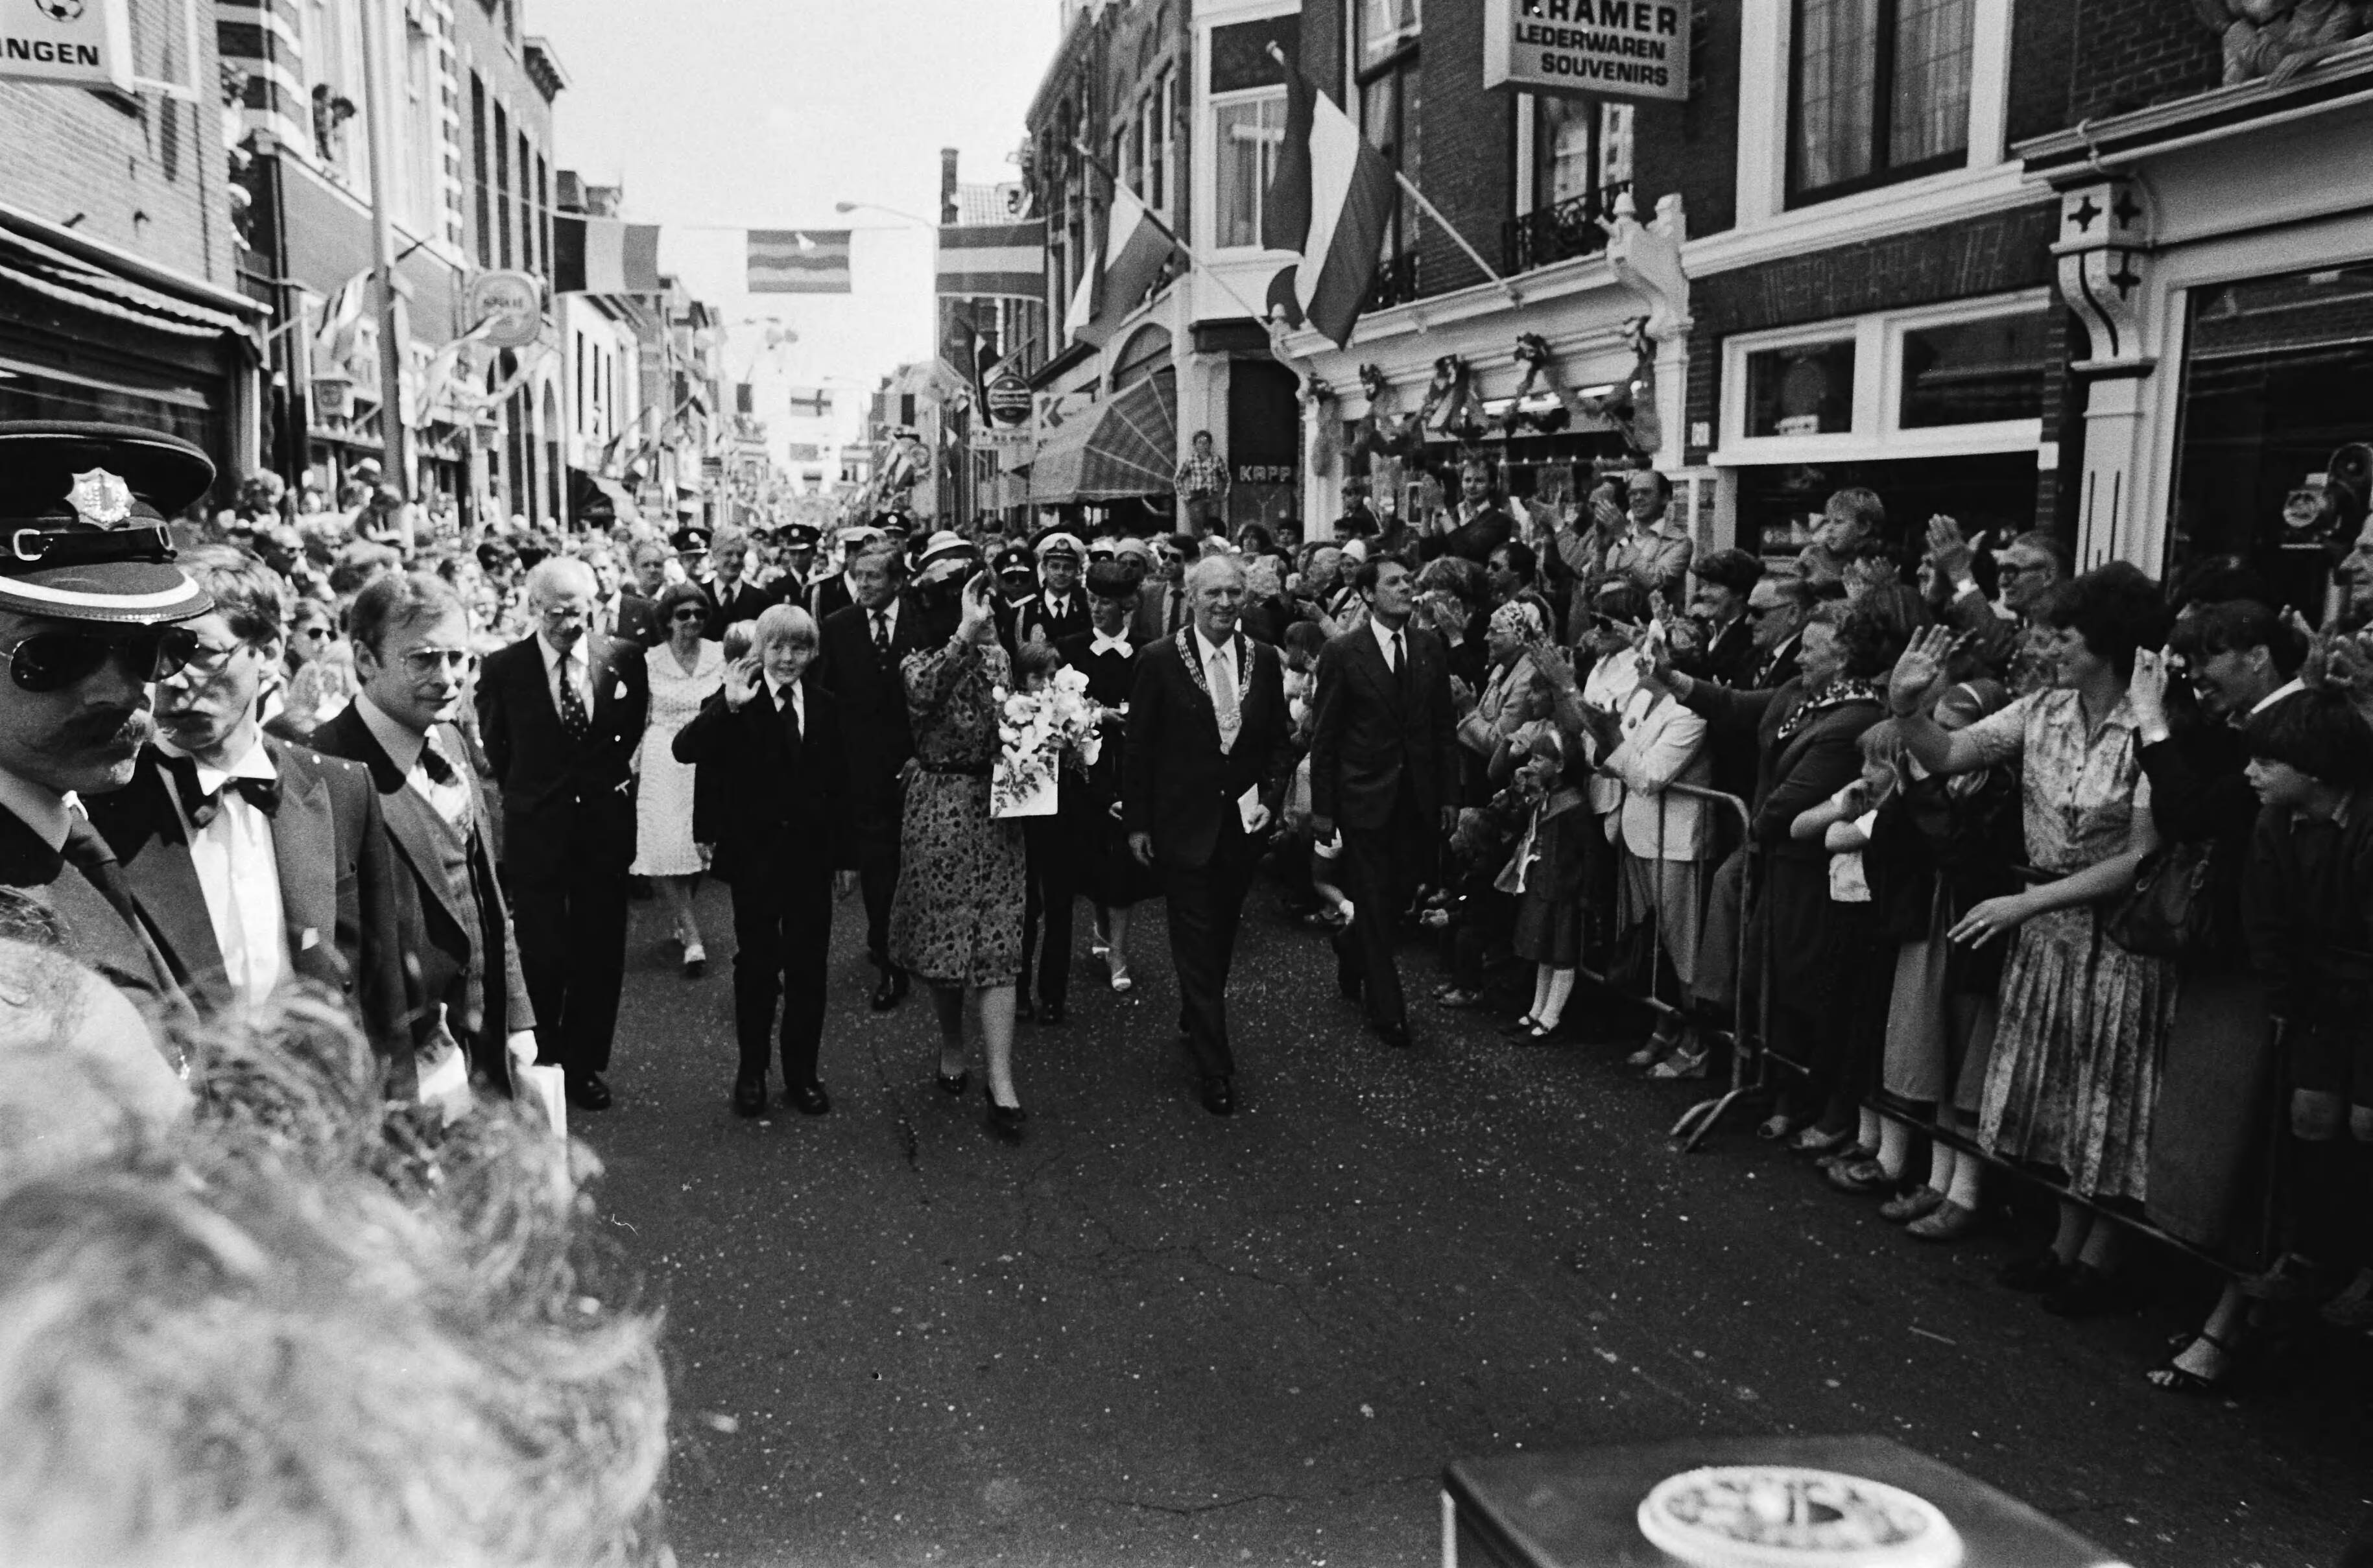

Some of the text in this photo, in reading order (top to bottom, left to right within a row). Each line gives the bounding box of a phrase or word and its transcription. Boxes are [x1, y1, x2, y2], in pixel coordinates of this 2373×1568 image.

[1523, 0, 1677, 36] KRAMER
[1516, 23, 1665, 60] LEDERWAREN
[1541, 53, 1669, 87] SOUVENIRS
